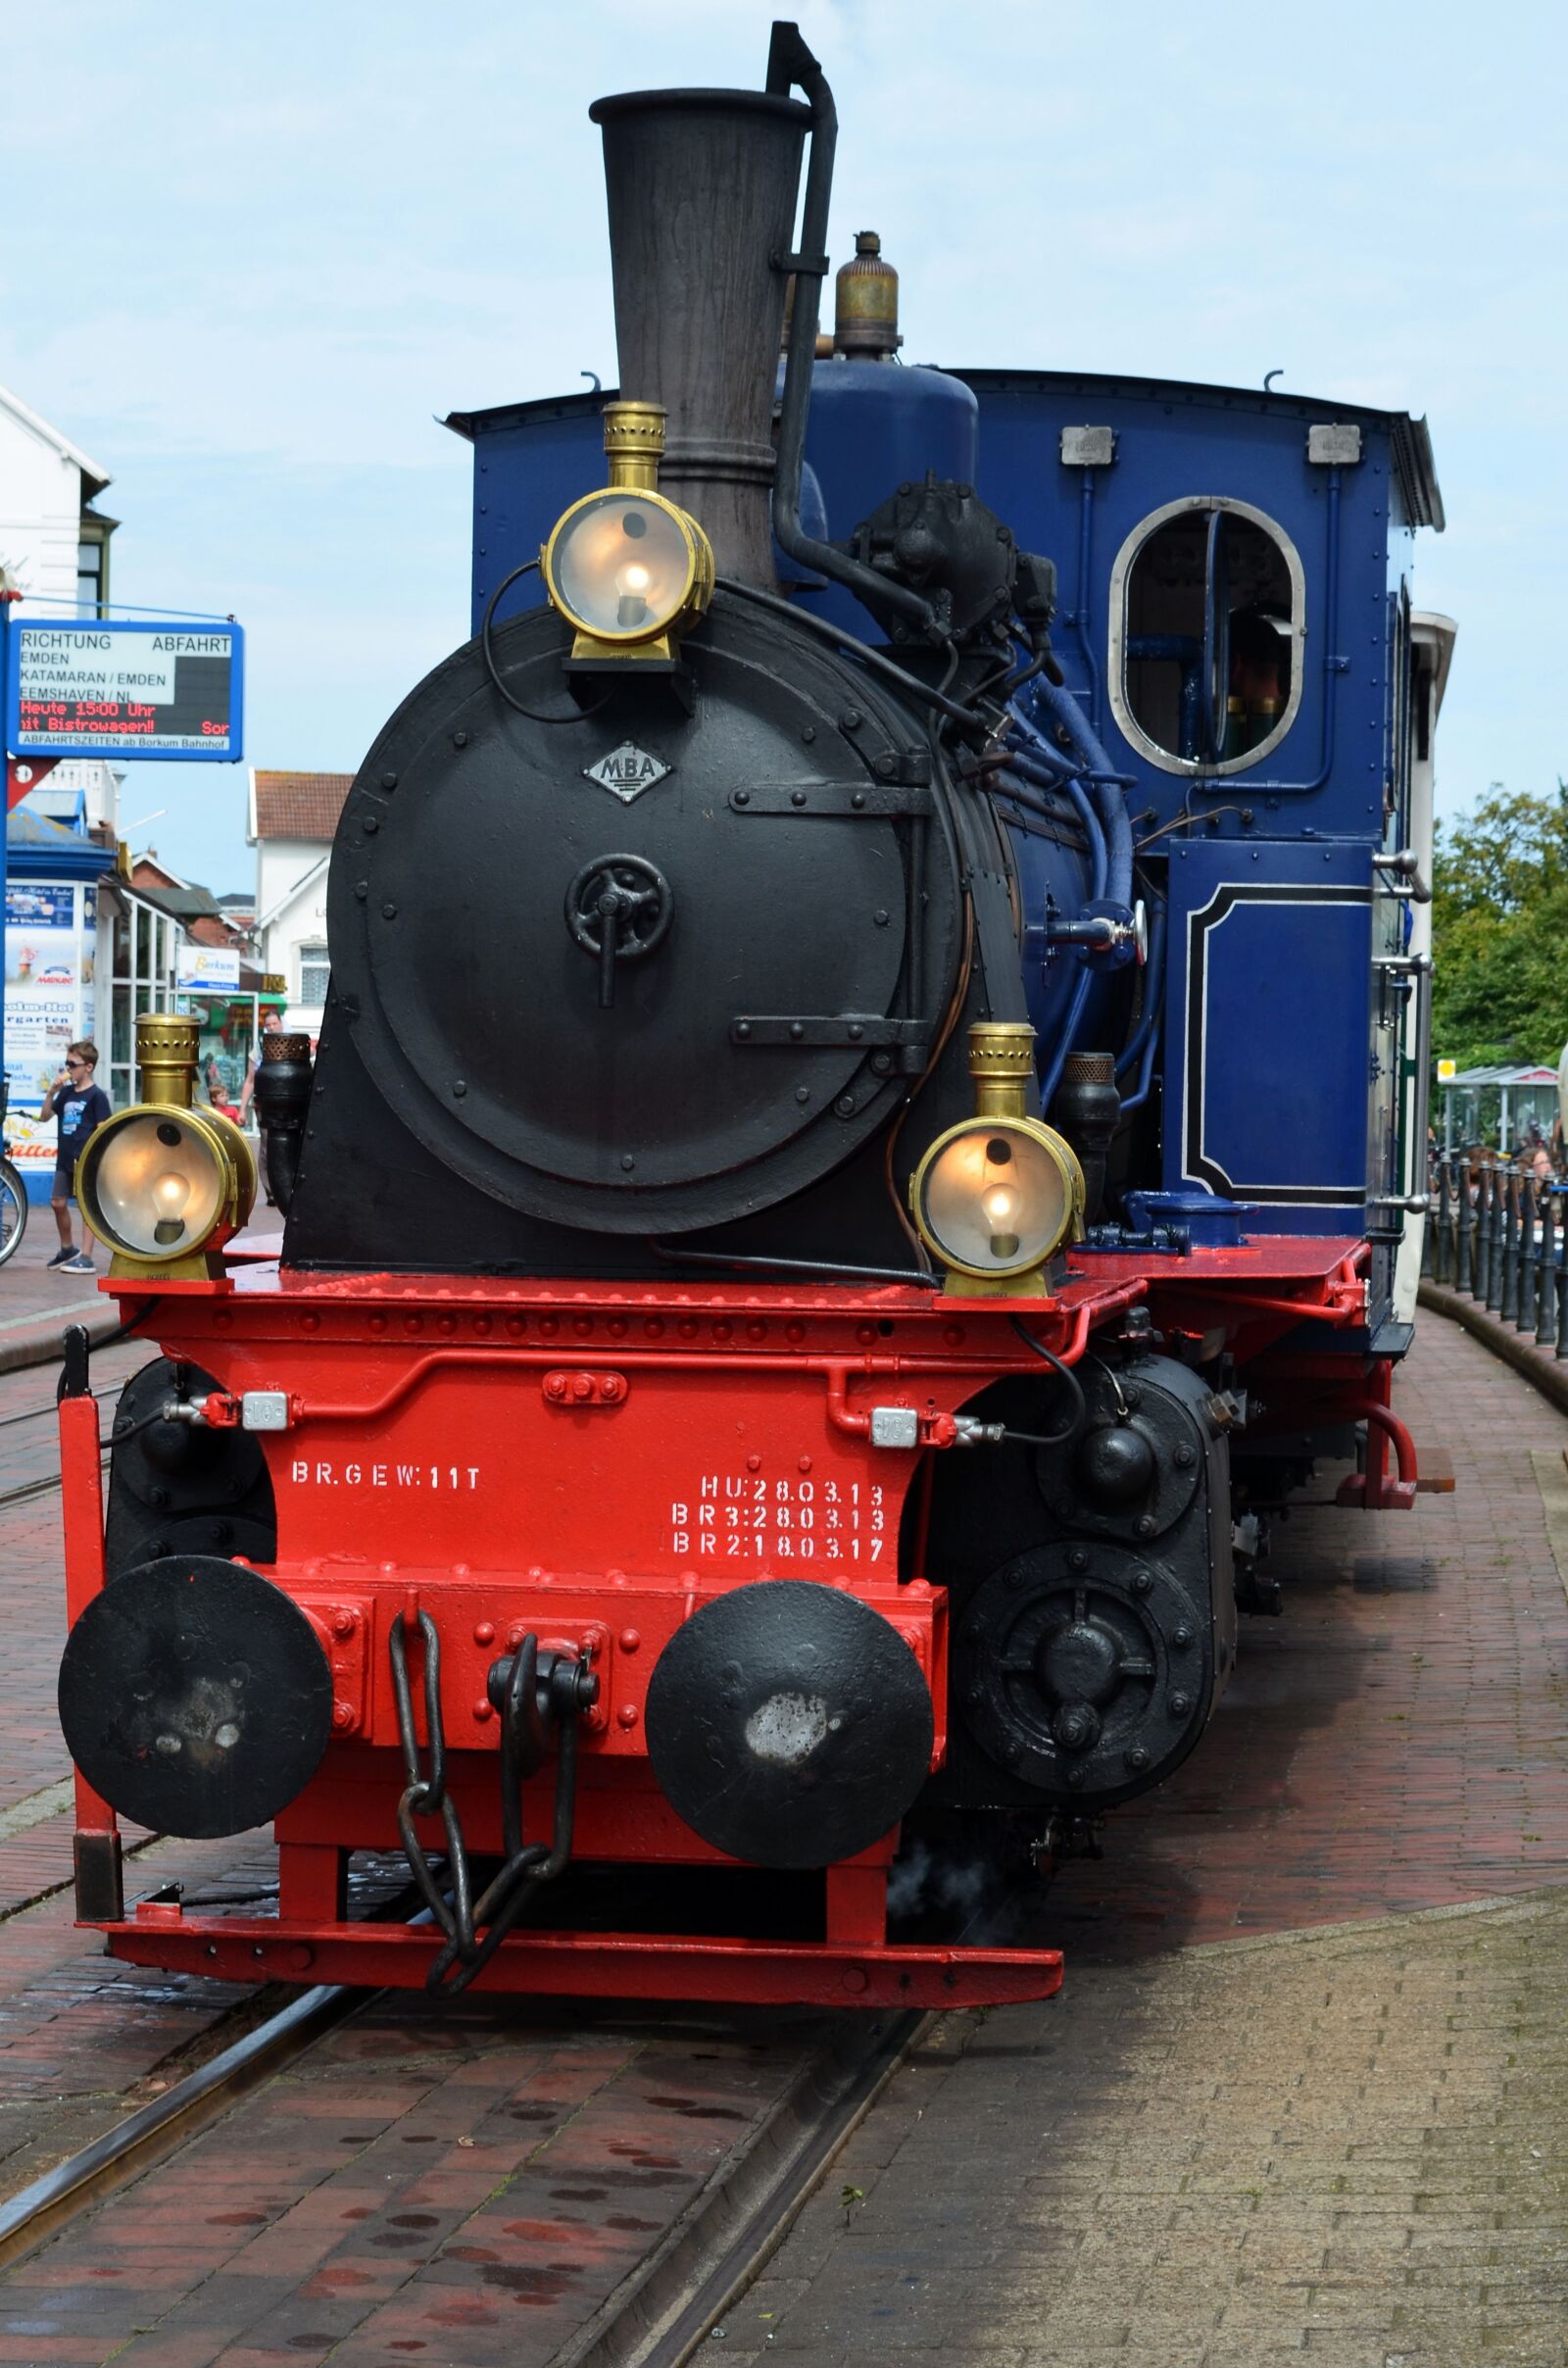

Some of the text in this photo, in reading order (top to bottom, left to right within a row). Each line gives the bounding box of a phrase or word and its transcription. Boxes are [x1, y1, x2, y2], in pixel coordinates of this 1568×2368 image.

[22, 632, 111, 649] RICHTUNG
[152, 636, 230, 652] ABFAHRT
[21, 652, 69, 665] EMDEN
[21, 669, 106, 683] KATAMARAN
[118, 673, 166, 686] EMDEN
[20, 687, 105, 702] EEMSHAVEN
[117, 691, 133, 703] NL
[21, 700, 156, 716] Heute 15:00 Uhr
[48, 717, 155, 734] Bistrowagen!!
[24, 735, 224, 749] ABFAHRTSZEITEN ab Borkum Bahnhof
[601, 758, 655, 778] MBA
